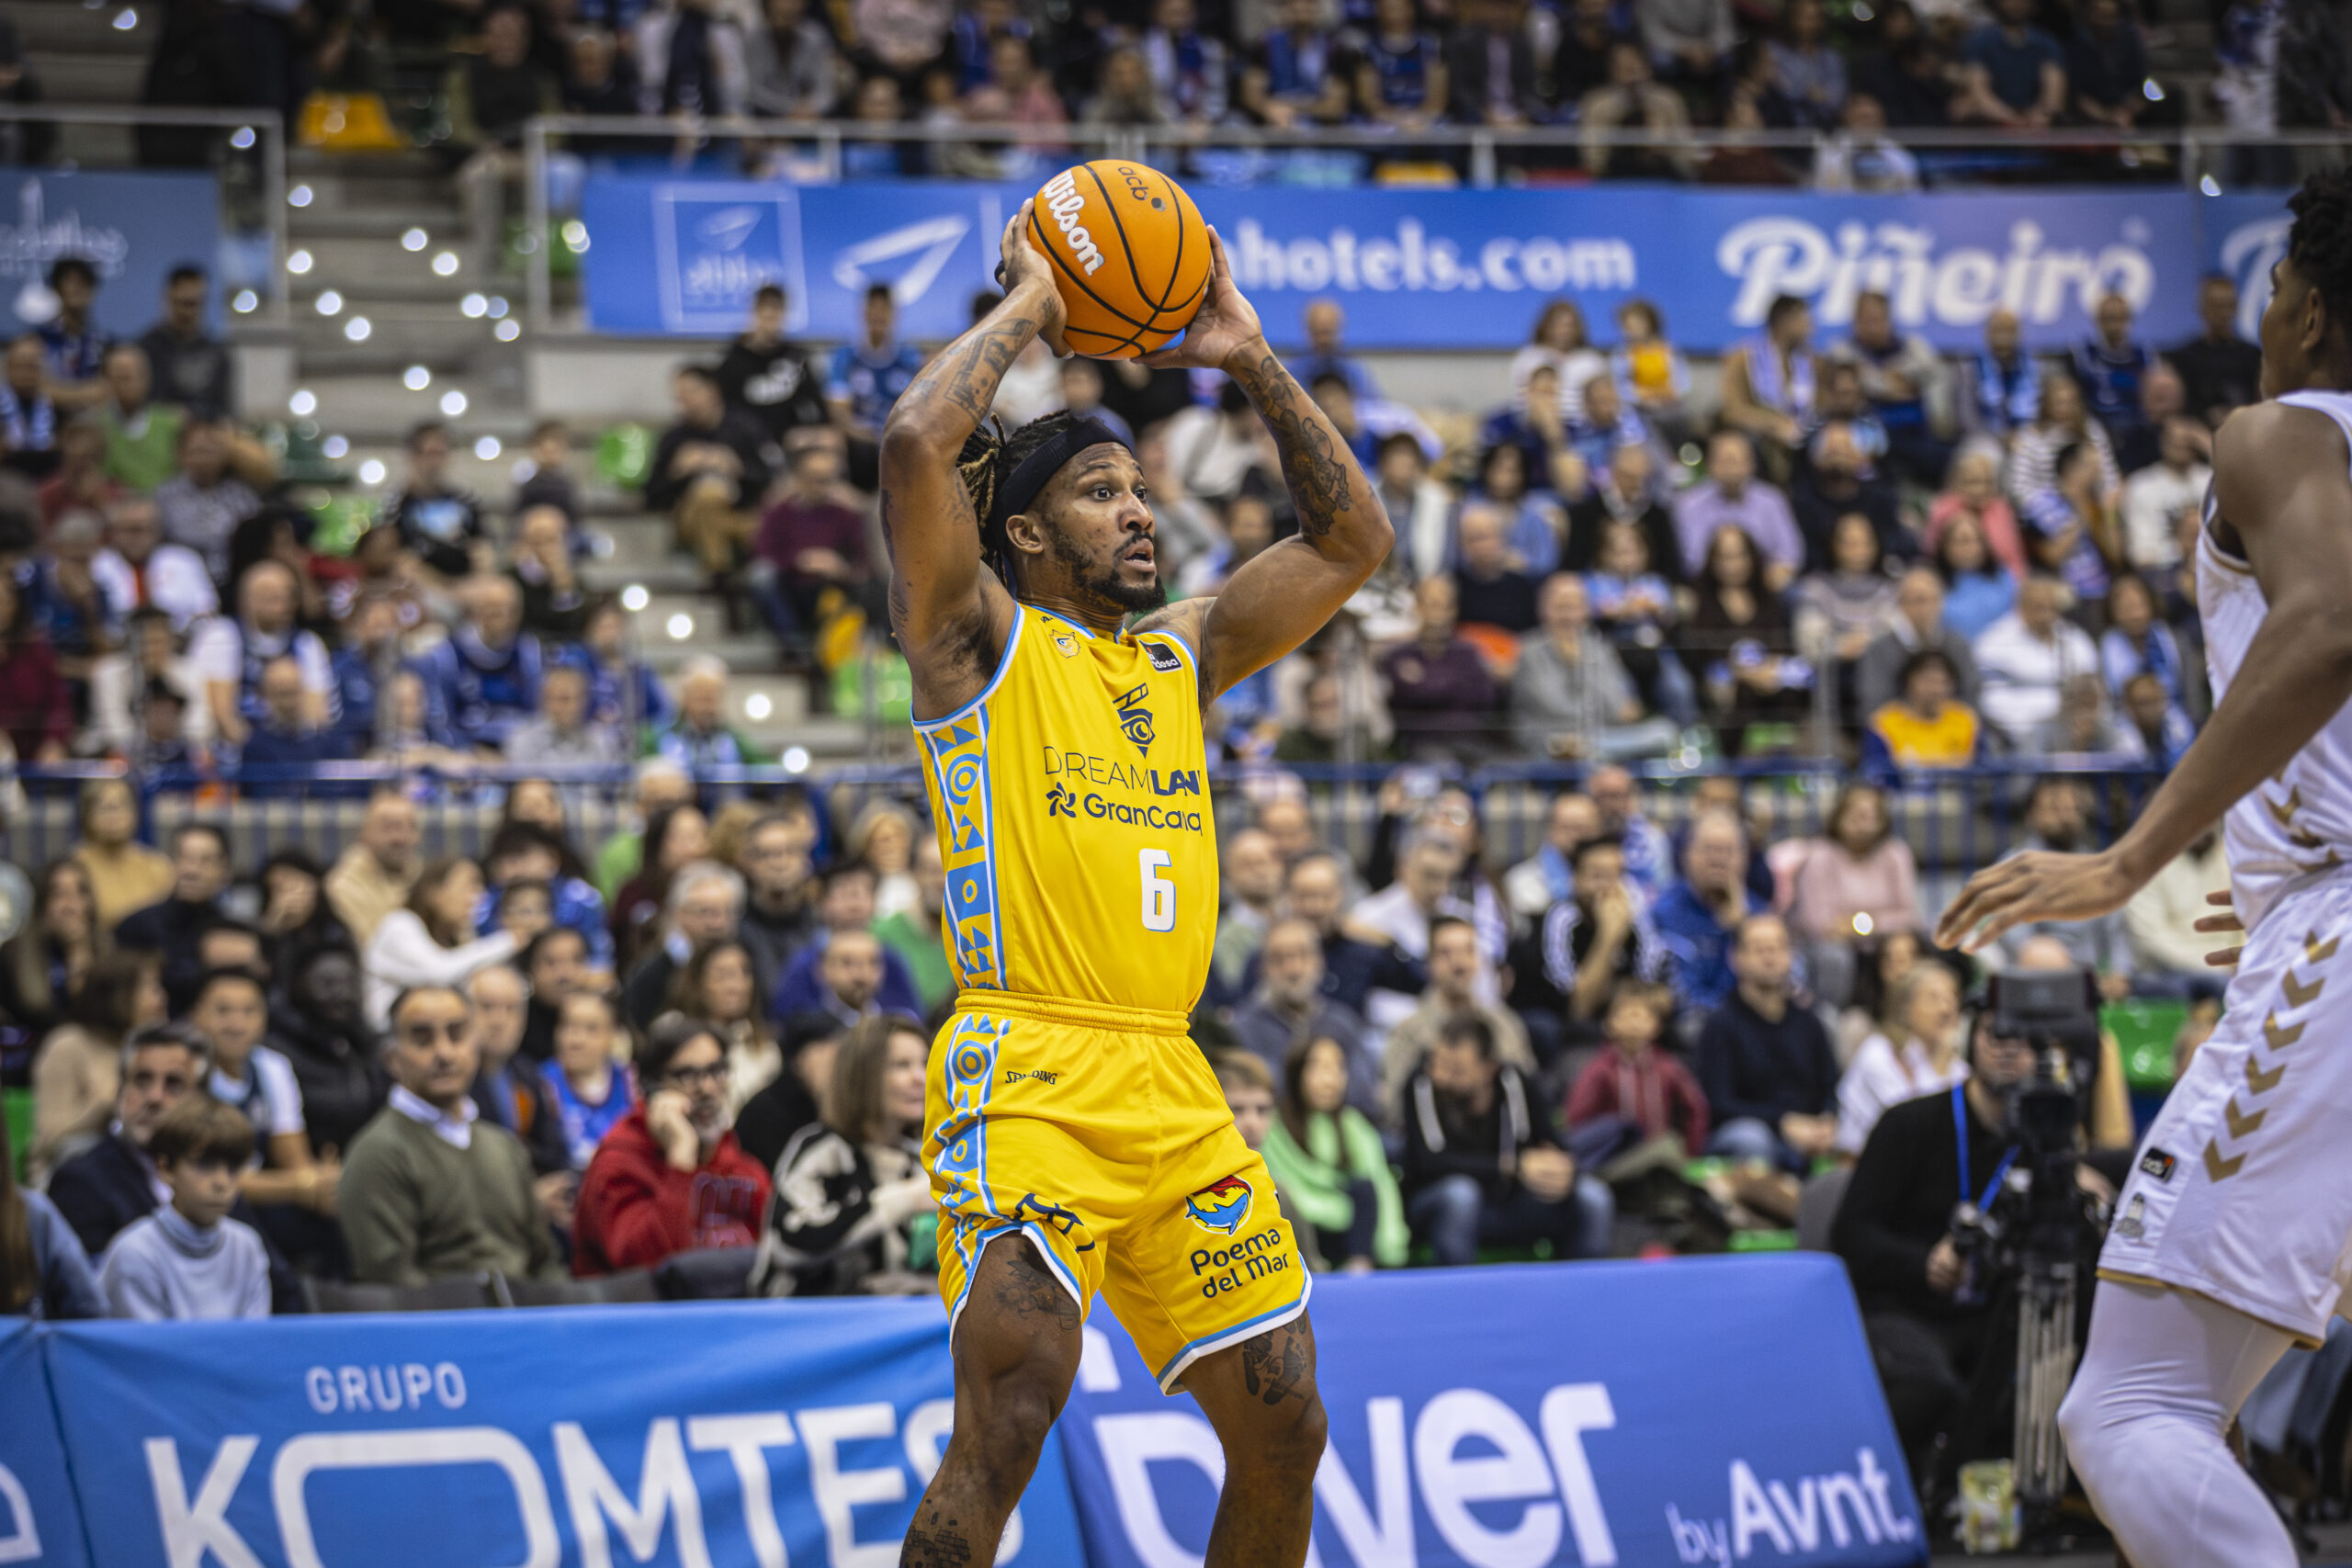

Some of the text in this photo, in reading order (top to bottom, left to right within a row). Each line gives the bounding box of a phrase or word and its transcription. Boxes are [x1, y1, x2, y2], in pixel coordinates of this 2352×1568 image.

[1117, 166, 1148, 201] acb
[1043, 169, 1105, 276] Wilson
[1225, 218, 1638, 292] hotels.com
[1716, 216, 2155, 327] Piñeiro
[1044, 746, 1201, 796] DREAMLAN
[1139, 848, 1176, 932] 6
[1005, 1070, 1058, 1085] SPDING
[1190, 1228, 1281, 1276] Poema
[1202, 1253, 1288, 1298] del Mar
[306, 1361, 468, 1414] GRUPO
[1665, 1446, 1916, 1568] by Avnt.
